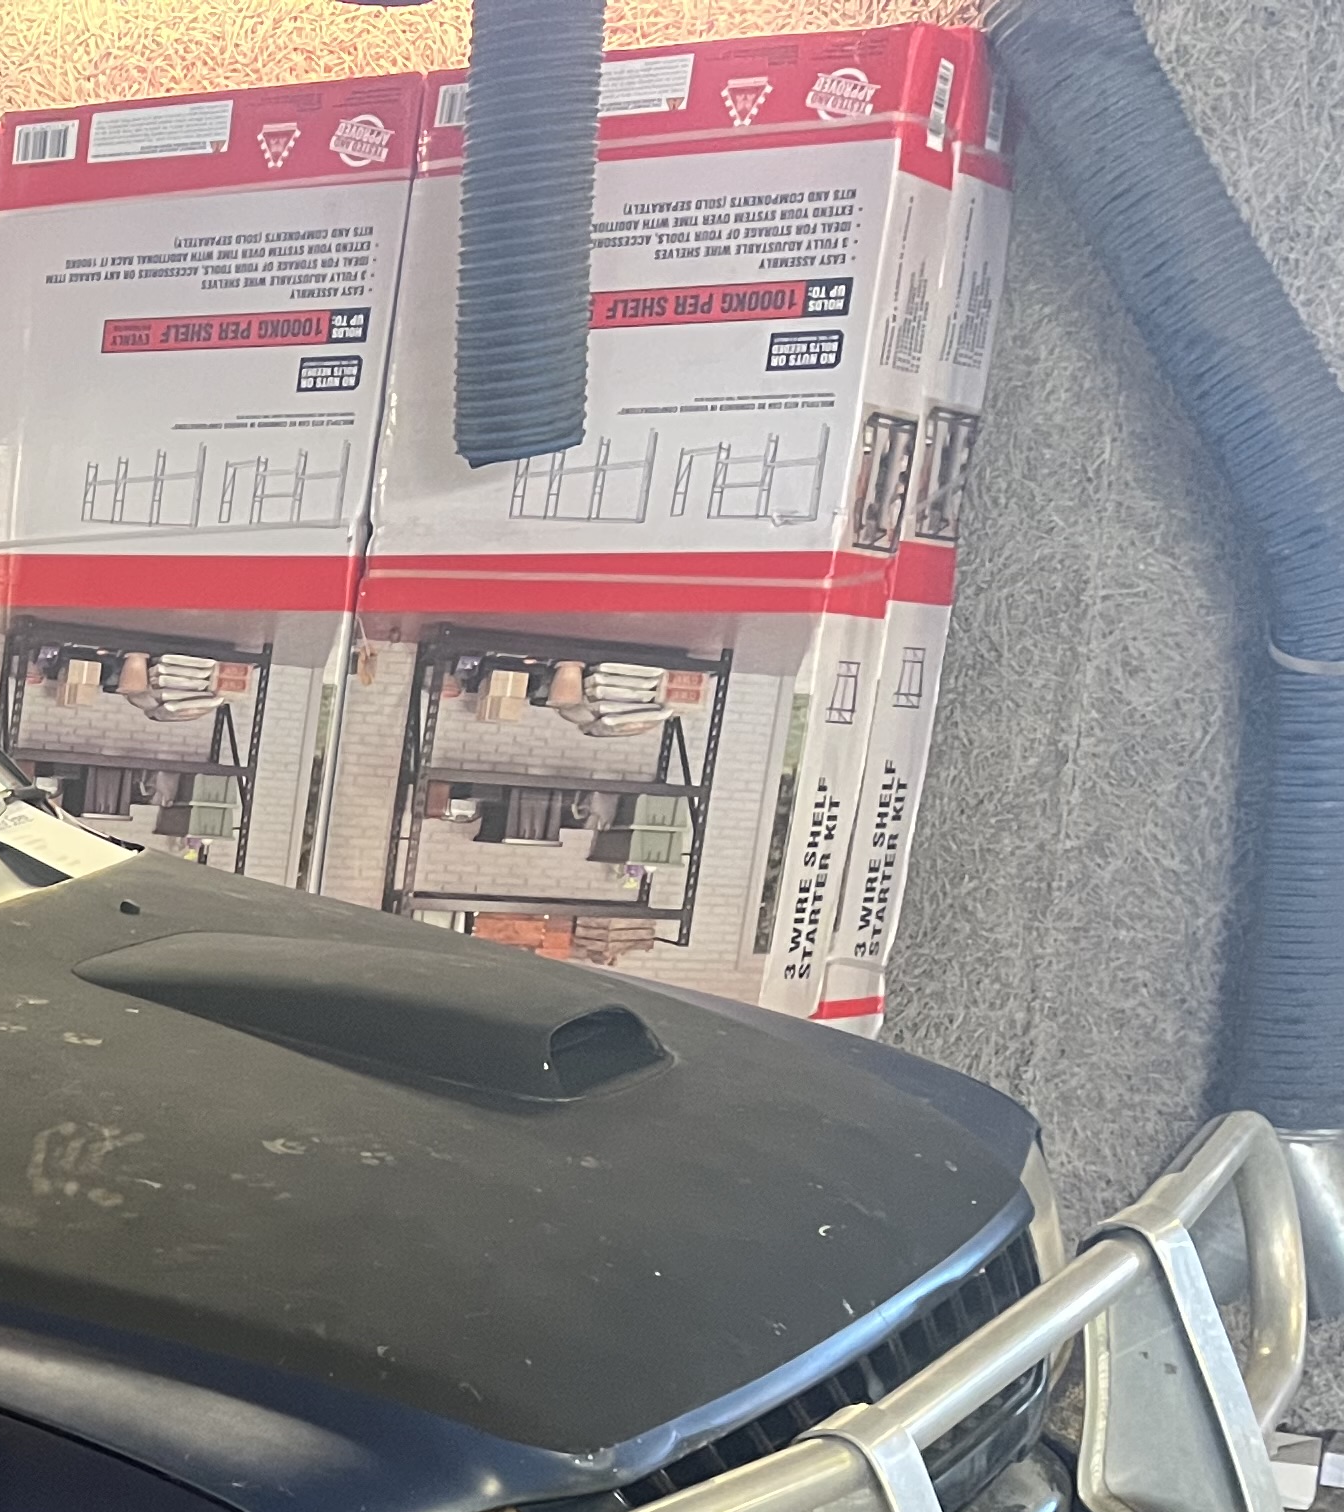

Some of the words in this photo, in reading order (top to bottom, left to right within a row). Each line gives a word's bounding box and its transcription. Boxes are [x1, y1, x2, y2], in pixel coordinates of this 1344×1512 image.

[812, 77, 875, 100] APPROVED
[336, 122, 389, 146] APPROVED
[729, 192, 805, 208] COMPONENTS
[807, 190, 830, 202] AND
[832, 189, 857, 200] KITS
[623, 199, 692, 216] SEPARATELY)
[694, 196, 727, 210] (SOLD
[733, 209, 777, 223] SYSTEM
[779, 207, 809, 220] YOUR
[812, 205, 854, 217] EXTEND
[642, 217, 669, 229] WITH
[672, 215, 699, 227] TIME
[702, 213, 730, 225] OVER
[330, 227, 350, 238] AND
[351, 225, 374, 237] KITS
[743, 224, 793, 239] STORAGE
[795, 223, 817, 234] FOR
[820, 220, 852, 232] IDEAL
[264, 227, 329, 243] COMPONENTS
[655, 229, 691, 243] TOOLS,
[693, 229, 722, 241] YOUR
[725, 228, 740, 239] OF
[173, 232, 233, 249] SEPARATELY)
[334, 240, 371, 252] EXTEND
[735, 238, 803, 255] ADJUSTABLE
[804, 237, 839, 250] FULLY
[842, 237, 849, 247] 3
[216, 248, 238, 260] TIME
[241, 246, 265, 258] OVER
[268, 244, 305, 257] SYSTEM
[306, 242, 332, 254] YOUR
[653, 245, 701, 260] SHELVES
[704, 244, 731, 256] WIRE
[110, 254, 134, 266] RACK
[135, 250, 188, 265] ADDITIONAL
[191, 250, 213, 261] WITH
[342, 255, 369, 267] IDEAL
[757, 254, 817, 269] ASSEMBLY
[817, 253, 847, 265] EASY
[234, 262, 259, 274] YOUR
[260, 261, 273, 272] OF
[275, 258, 318, 272] STORAGE
[320, 257, 340, 268] FOR
[68, 271, 102, 284] GARAGE
[102, 270, 121, 282] ANY
[137, 264, 198, 280] ACCESSORIES
[269, 271, 327, 286] ADJUSTABLE
[328, 270, 358, 282] FULLY
[359, 270, 367, 280] 3
[45, 273, 66, 285] ITEM
[200, 276, 240, 290] SHELVES
[243, 275, 266, 287] WIRE
[289, 285, 338, 300] ASSEMBLY
[340, 284, 364, 296] EASY
[807, 285, 826, 298] TO:
[827, 284, 846, 297] UP
[673, 293, 715, 315] PER
[719, 288, 796, 312] 1000KG
[808, 297, 844, 311] HOLDS
[604, 295, 669, 319] SHELF
[331, 315, 346, 326] TO:
[348, 314, 364, 325] UP
[158, 321, 213, 344] SHELF
[217, 319, 253, 341] PER
[258, 315, 322, 339] 1000KG
[331, 326, 362, 339] HOLDS
[109, 332, 150, 347] EVENLY
[771, 343, 807, 354] NEEDED
[809, 341, 838, 352] BOLTS
[770, 354, 786, 366] OR
[788, 353, 817, 365] NUTS
[819, 352, 836, 363] NO
[873, 759, 896, 848] SHELF
[804, 776, 828, 867] SHELF
[869, 833, 899, 956] STARTER
[892, 778, 908, 821] KIT
[798, 852, 831, 979] STARTER
[824, 795, 840, 840] KIT
[858, 858, 882, 931] WIRE
[789, 879, 813, 953] WIRE
[854, 941, 866, 958] 3
[784, 964, 797, 979] 3
